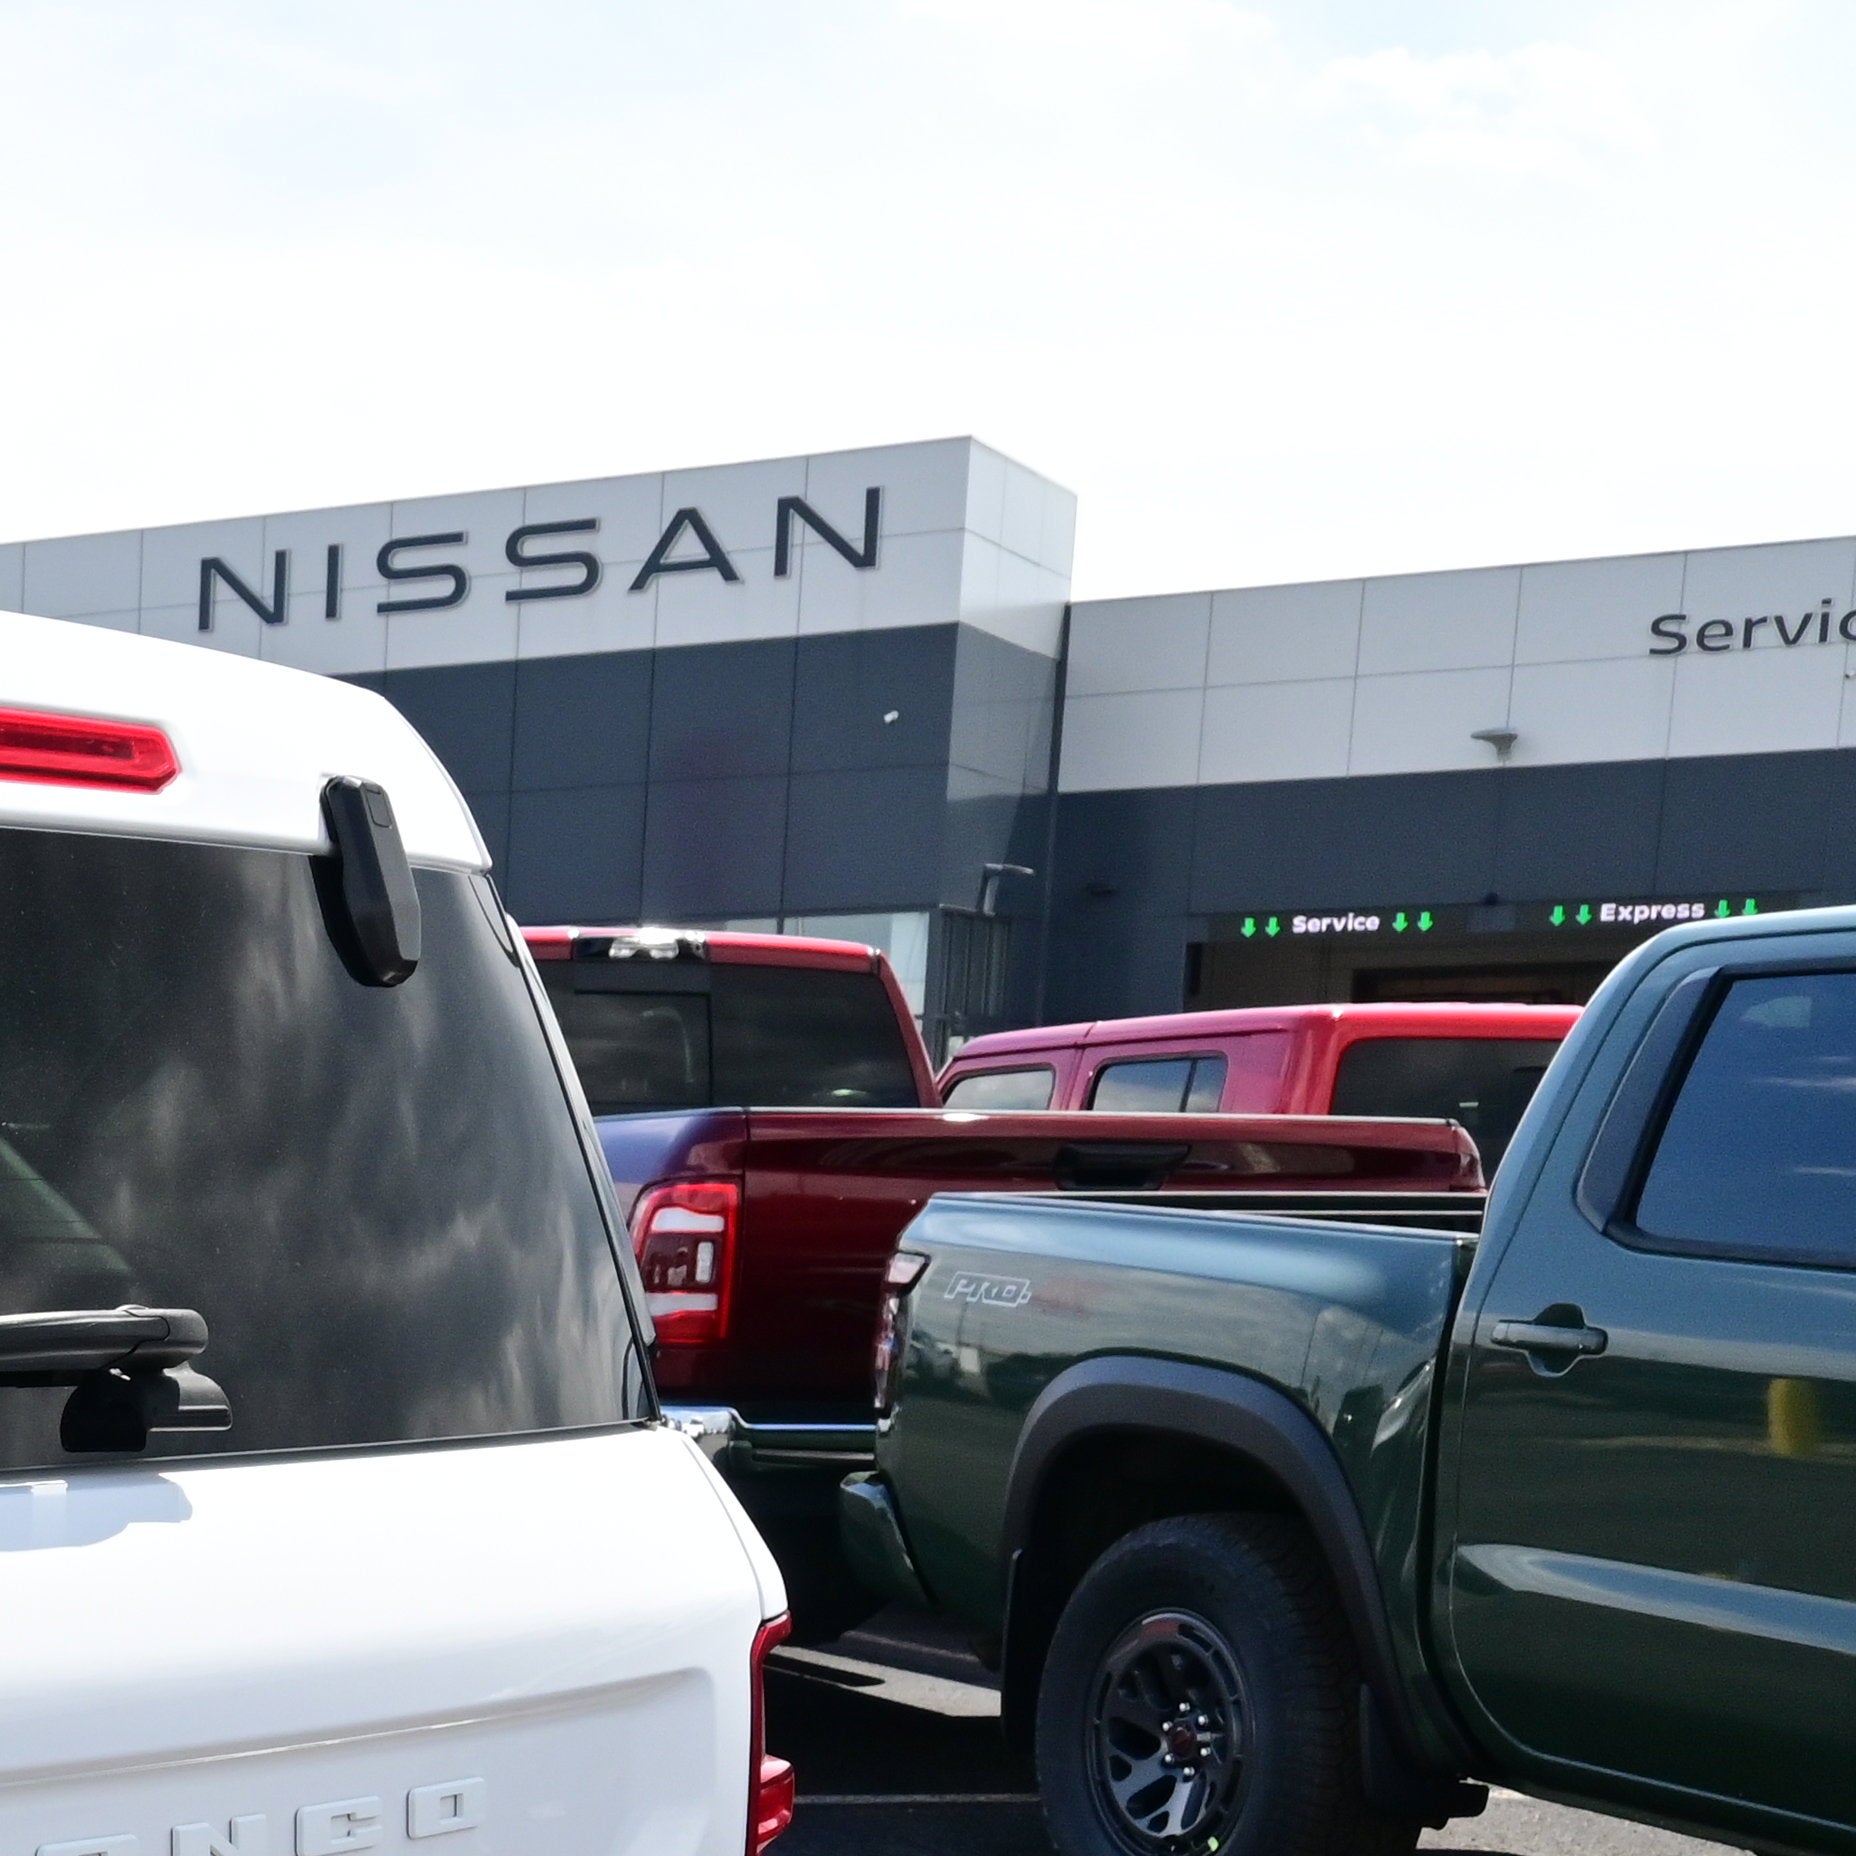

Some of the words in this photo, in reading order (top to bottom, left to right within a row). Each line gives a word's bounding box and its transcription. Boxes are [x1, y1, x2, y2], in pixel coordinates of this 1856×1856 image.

[198, 485, 885, 632] NISSAN
[1291, 912, 1381, 934] Service
[1599, 902, 1706, 925] Express
